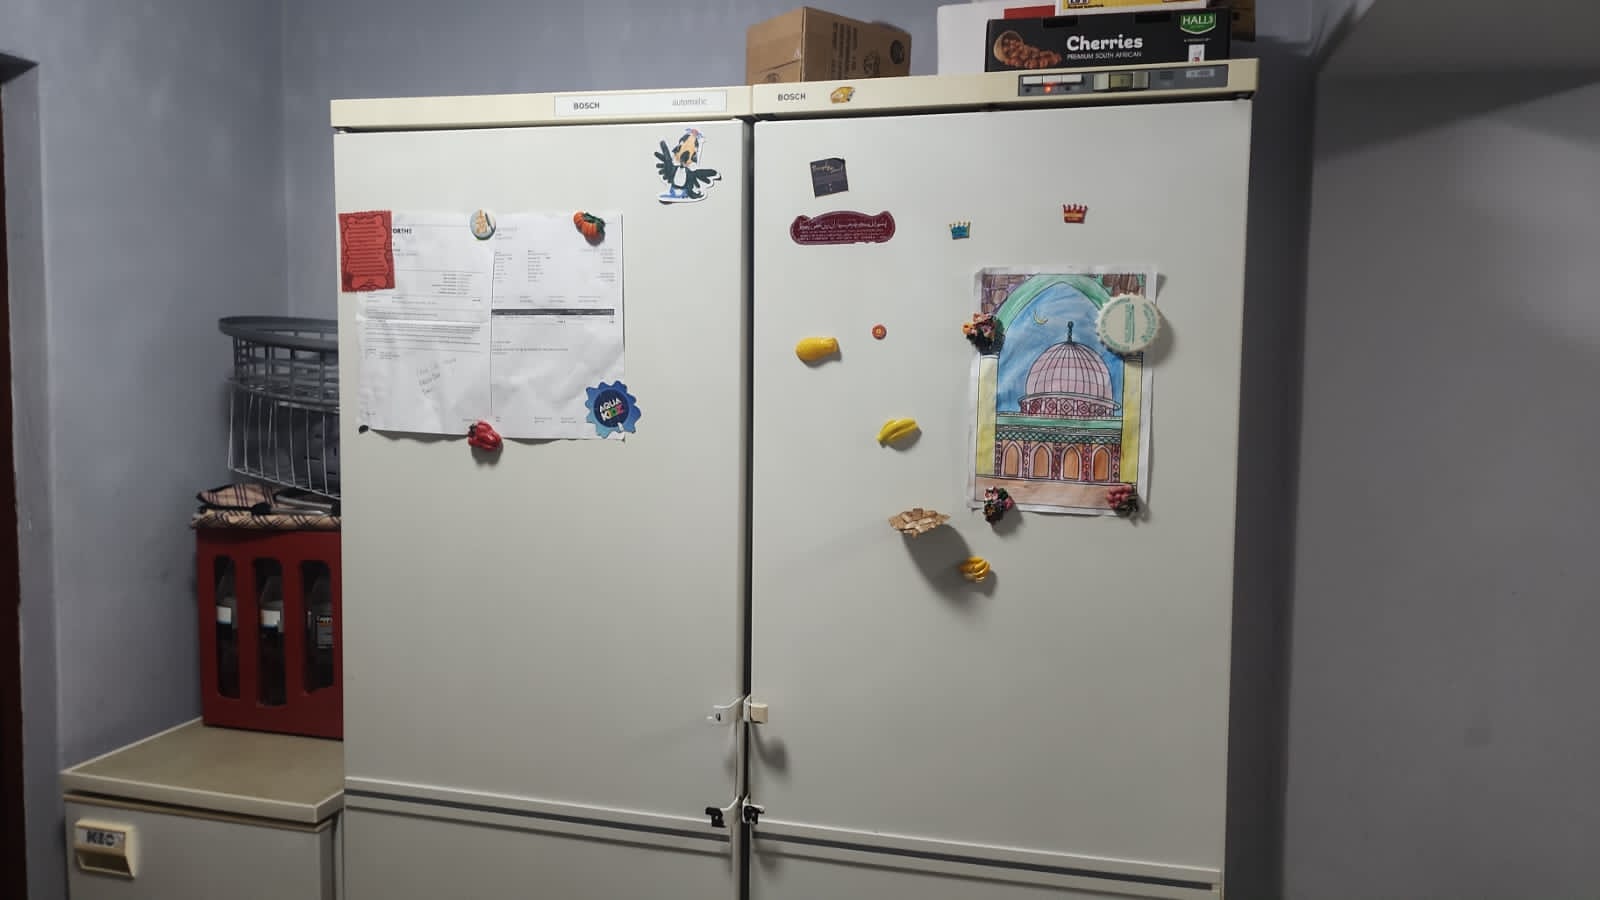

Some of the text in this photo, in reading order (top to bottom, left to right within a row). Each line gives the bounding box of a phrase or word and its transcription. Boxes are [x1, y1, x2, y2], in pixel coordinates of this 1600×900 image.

[1066, 33, 1143, 51] Cherries
[1067, 52, 1094, 60] PREMIUM
[1115, 50, 1142, 58] AFRICAN
[573, 96, 707, 110] BOSCH automatic
[777, 93, 806, 101] BOSCH
[600, 398, 622, 413] AQUA
